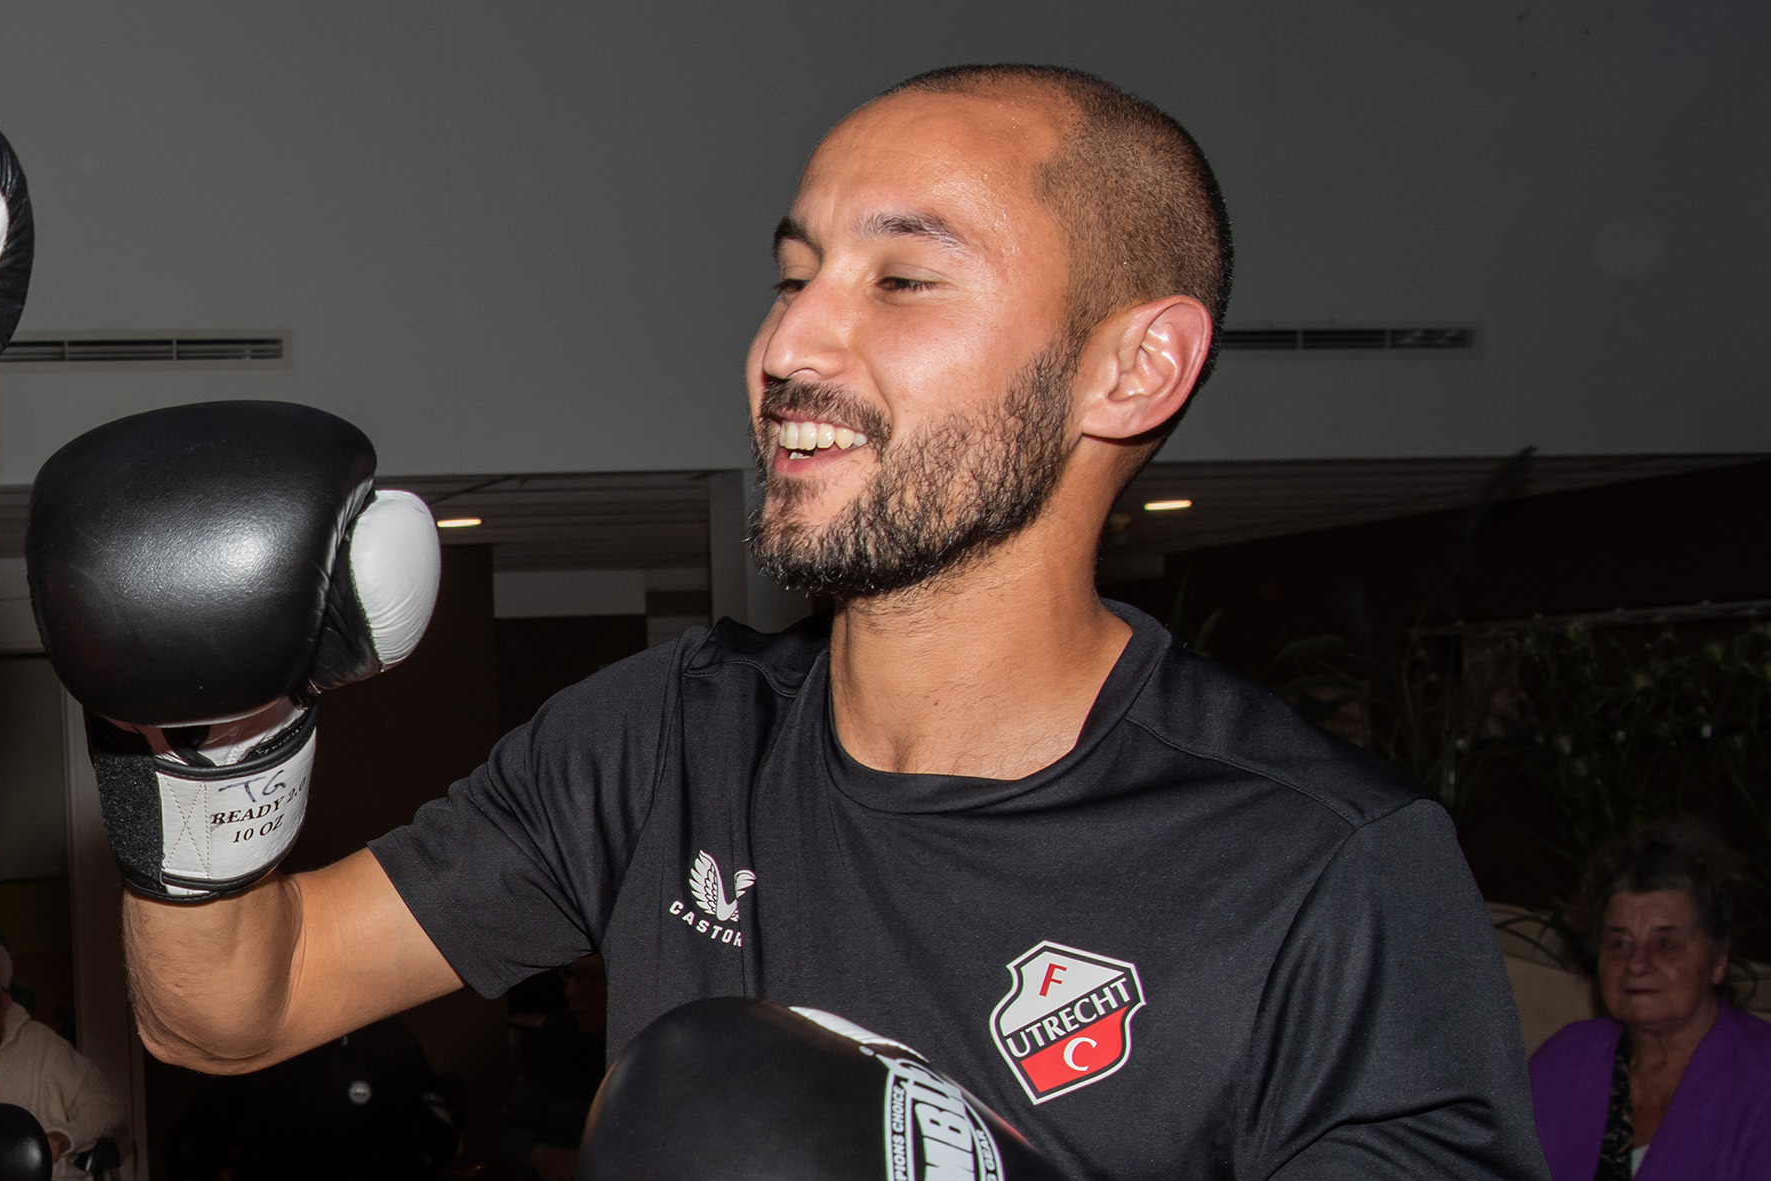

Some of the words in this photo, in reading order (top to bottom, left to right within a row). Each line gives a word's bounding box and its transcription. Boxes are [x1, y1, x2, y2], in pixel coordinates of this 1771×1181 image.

[210, 795, 285, 825] READY
[287, 777, 306, 803] 2.0
[218, 770, 286, 803] TG
[233, 828, 254, 843] 10
[259, 814, 284, 836] OZ
[1038, 962, 1068, 997] F
[1005, 977, 1131, 1058] UTRECHT
[1062, 1036, 1098, 1072] C
[890, 1084, 906, 1134] CHOICE
[975, 1129, 996, 1172] GEAR
